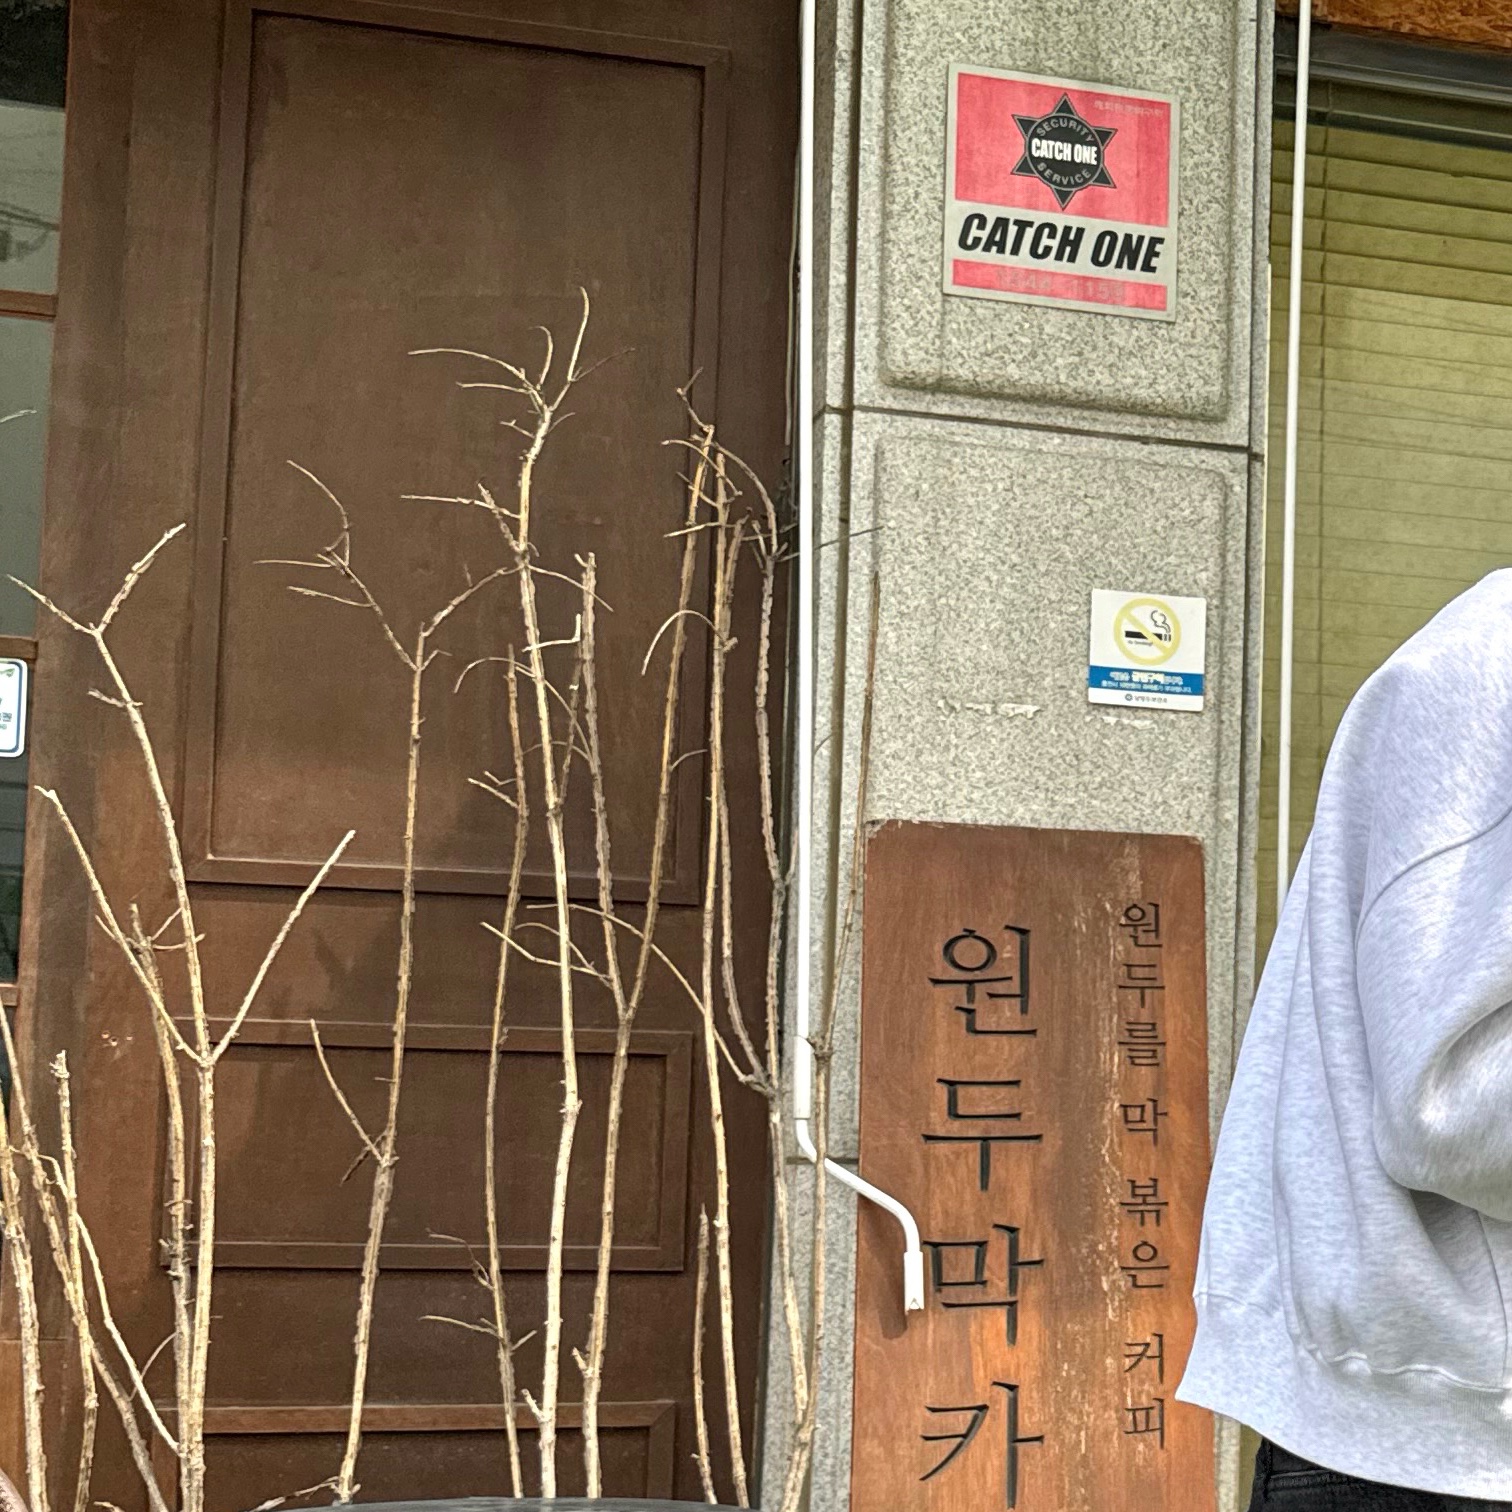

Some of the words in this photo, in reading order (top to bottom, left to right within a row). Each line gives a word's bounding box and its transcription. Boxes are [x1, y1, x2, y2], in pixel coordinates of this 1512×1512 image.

[1031, 138, 1072, 161] CATCH
[1074, 143, 1097, 165] ONE
[1036, 118, 1095, 142] SECURITY
[1037, 162, 1091, 185] SERVICE
[958, 213, 1085, 263] CATCH
[1091, 230, 1165, 273] ONE
[1117, 902, 1167, 1067] 원두를
[1119, 1097, 1168, 1147] 막
[1119, 1176, 1170, 1290] 볶은
[1123, 1332, 1164, 1450] 커피
